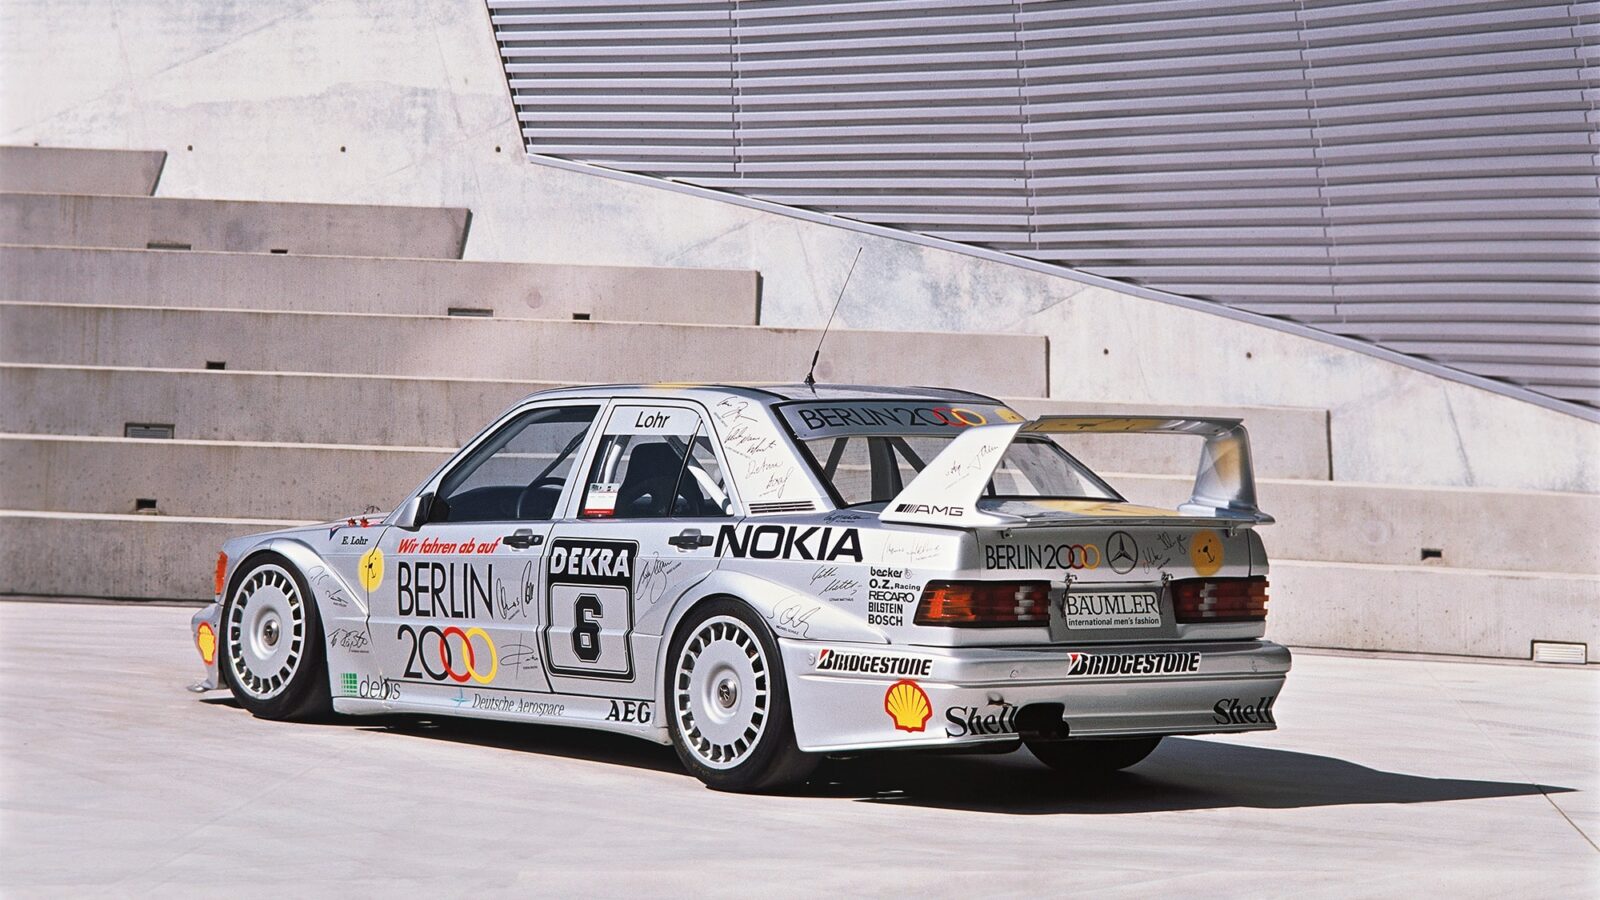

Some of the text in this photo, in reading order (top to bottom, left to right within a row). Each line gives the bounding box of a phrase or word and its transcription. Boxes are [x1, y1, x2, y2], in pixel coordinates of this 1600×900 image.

[635, 411, 671, 429] Lohr
[798, 407, 987, 430] BERLIN 2000
[915, 504, 964, 517] AMG
[350, 535, 369, 545] Lohr
[398, 537, 502, 554] Wir fahren ab auf
[714, 524, 863, 562] NOKIA
[550, 546, 630, 578] DEKRA
[985, 543, 1101, 570] BERLIN 2000
[870, 566, 903, 578] becker
[398, 561, 494, 619] BERLIN
[869, 578, 921, 591] O.Z. Racing
[868, 590, 915, 603] RECARO
[868, 601, 904, 615] BILSTEIN
[1066, 594, 1163, 616] BÄUMLER
[571, 592, 604, 664] 6
[868, 613, 904, 627] BOSCH
[1068, 615, 1160, 627] international men's fashion
[397, 623, 498, 684] 2000
[816, 649, 933, 676] BRIDGESTONE
[1067, 653, 1200, 676] BRIDGESTONE
[359, 673, 401, 701] debis
[472, 693, 565, 717] Deutsche Aerospace
[605, 700, 651, 724] AEG
[1212, 696, 1276, 725] Shell
[945, 705, 1019, 739] Shell
